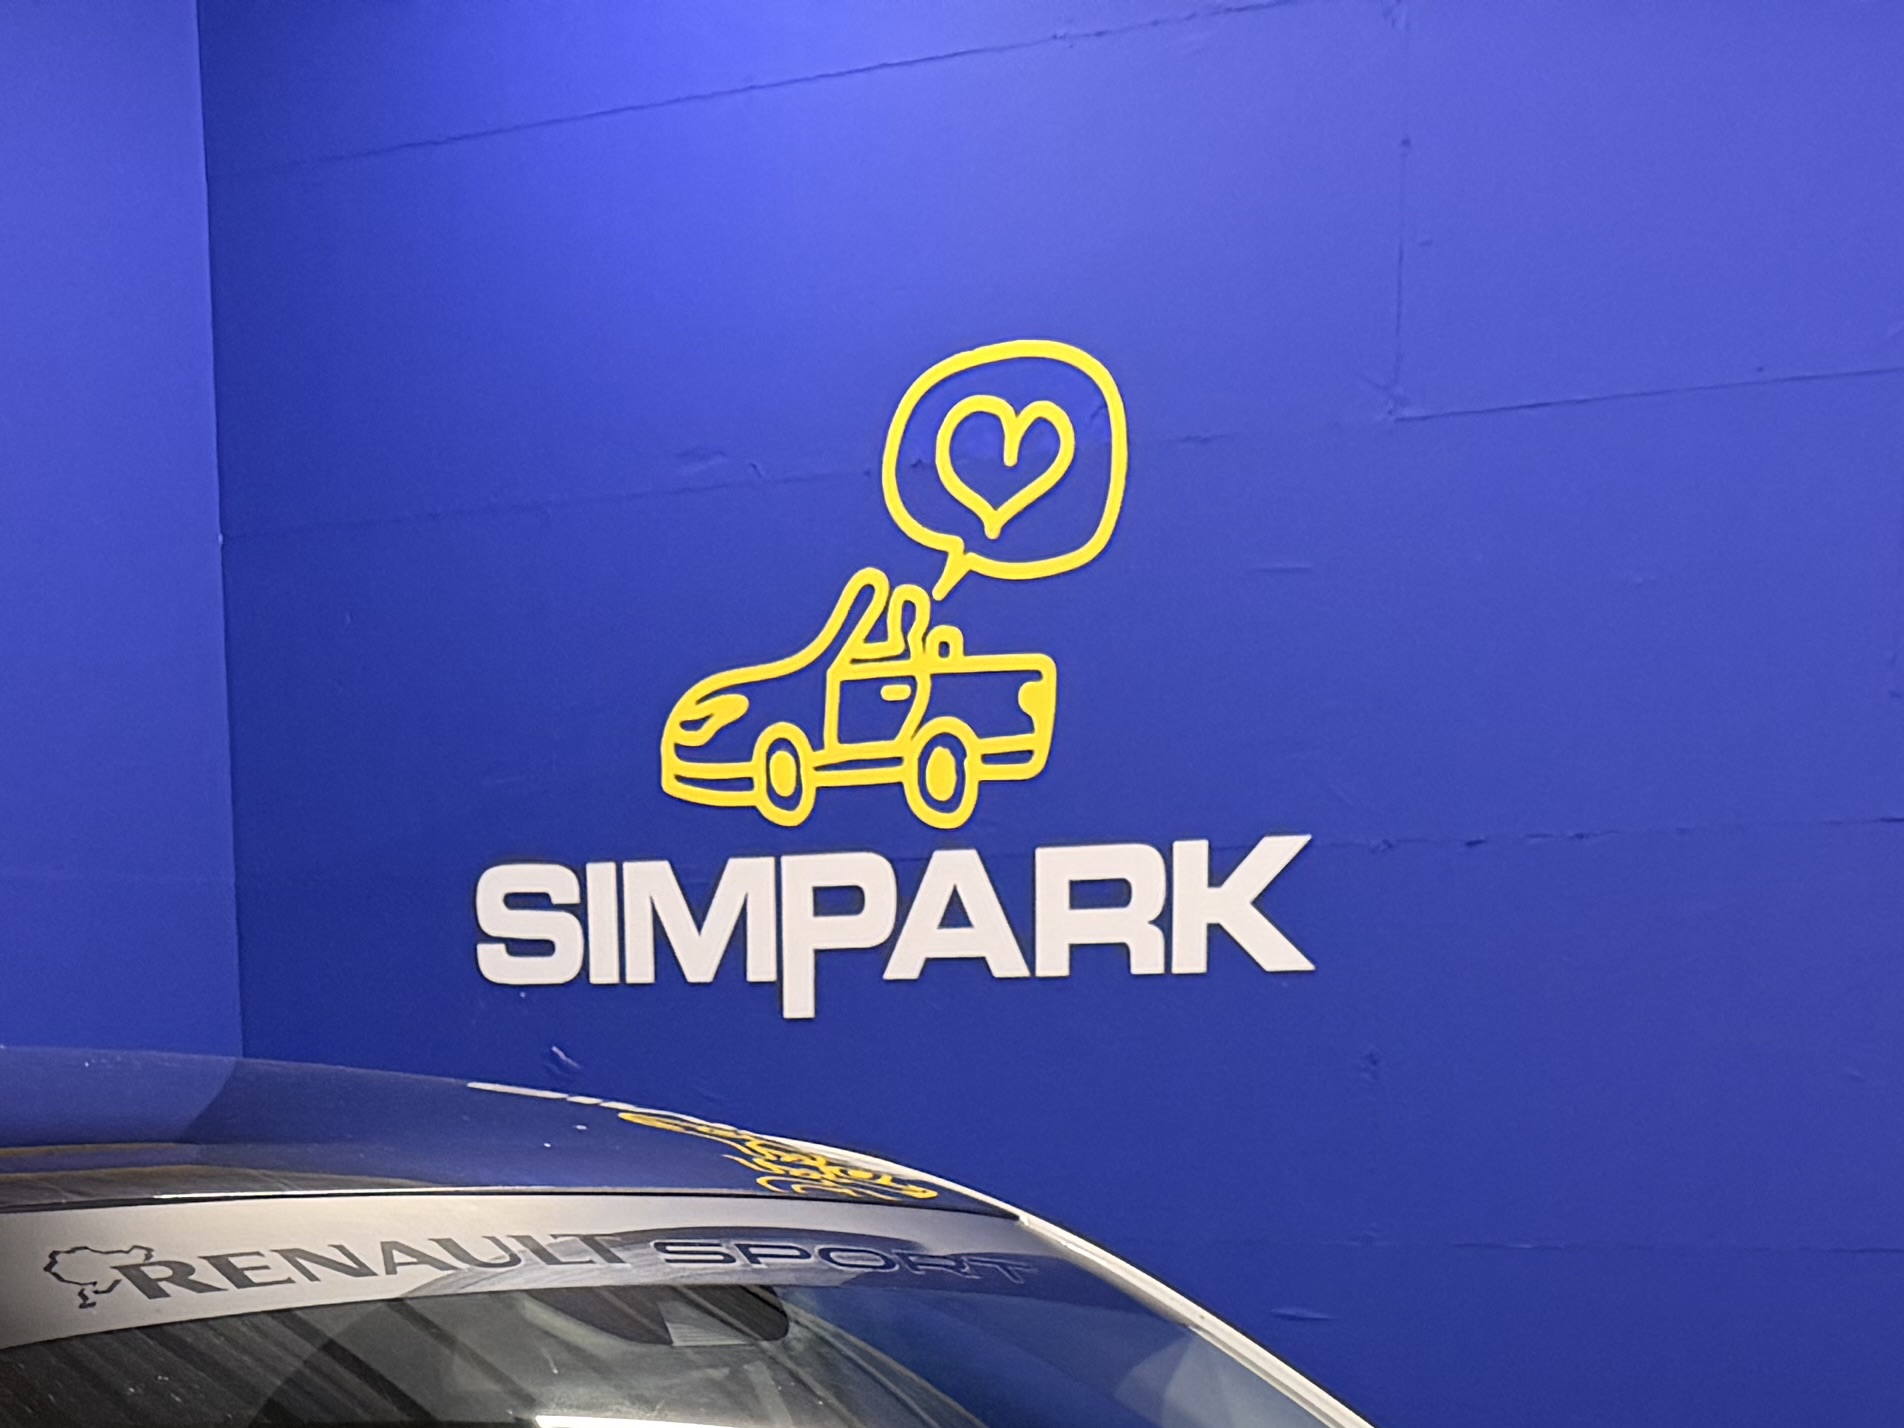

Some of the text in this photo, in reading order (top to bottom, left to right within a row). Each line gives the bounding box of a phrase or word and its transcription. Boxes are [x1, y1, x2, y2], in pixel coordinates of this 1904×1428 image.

[474, 833, 1316, 1019] SIMPARK
[109, 1233, 1039, 1300] RENAULT SPORT
